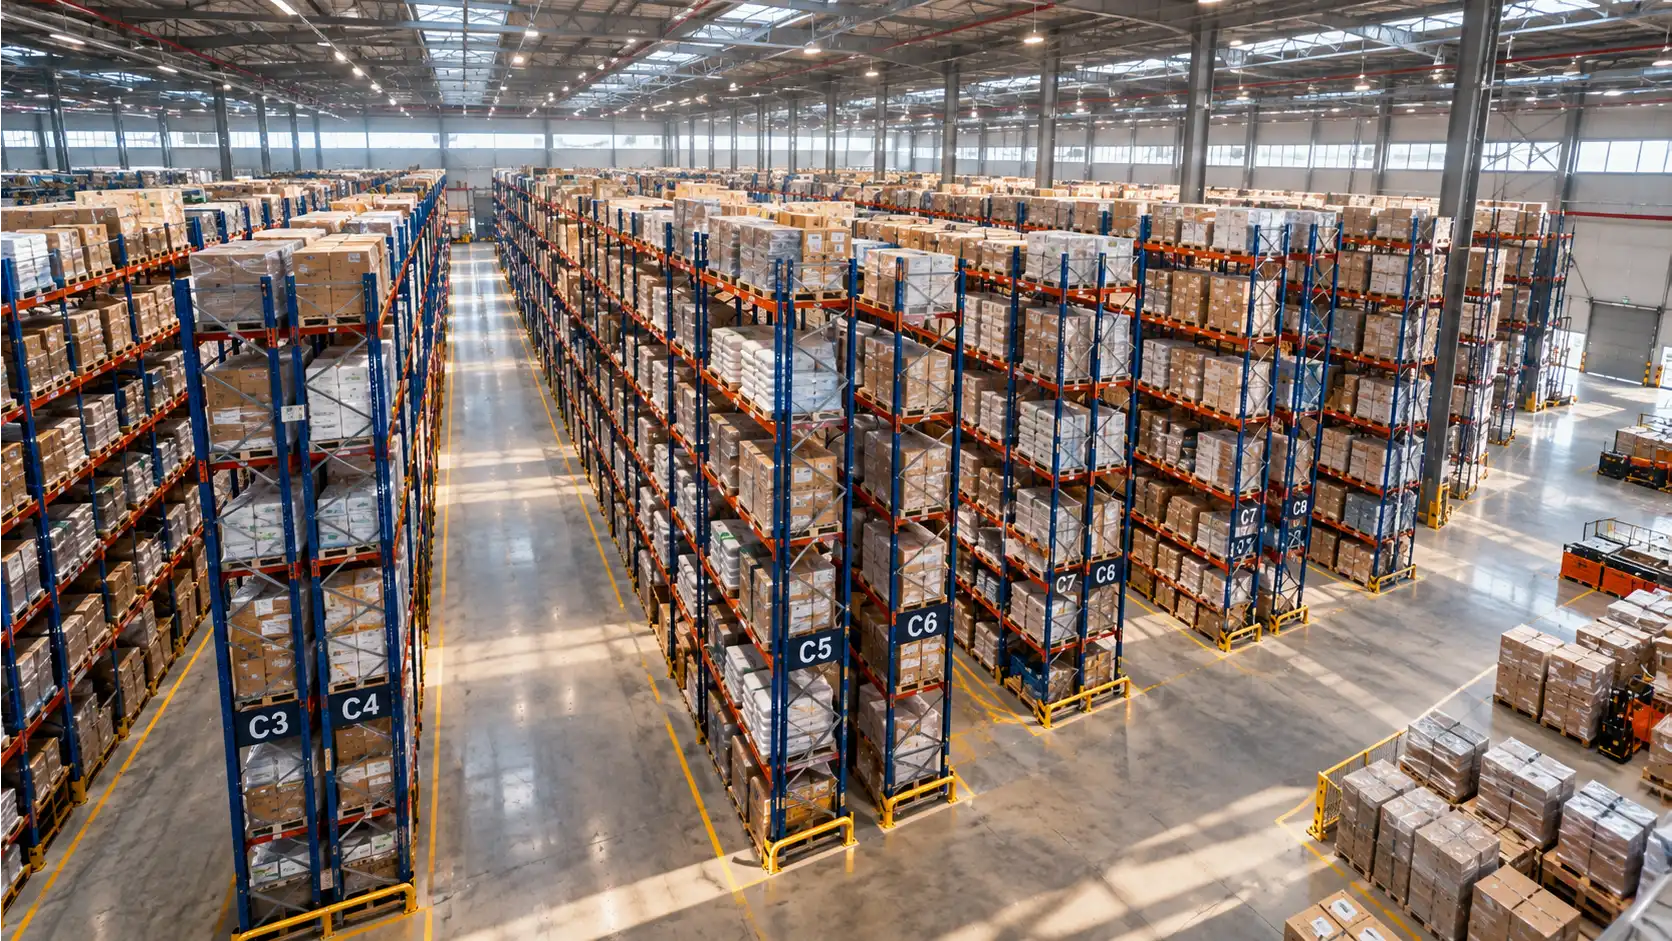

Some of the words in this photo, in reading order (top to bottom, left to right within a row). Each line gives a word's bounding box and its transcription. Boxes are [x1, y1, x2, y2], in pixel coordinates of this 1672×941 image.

[1241, 508, 1257, 525] C7
[1293, 500, 1308, 515] C8
[1056, 573, 1077, 594] C7
[1096, 564, 1115, 583] C6
[908, 612, 937, 637] C6
[800, 636, 832, 663] C5
[342, 693, 379, 720] C4
[249, 711, 289, 739] C3
